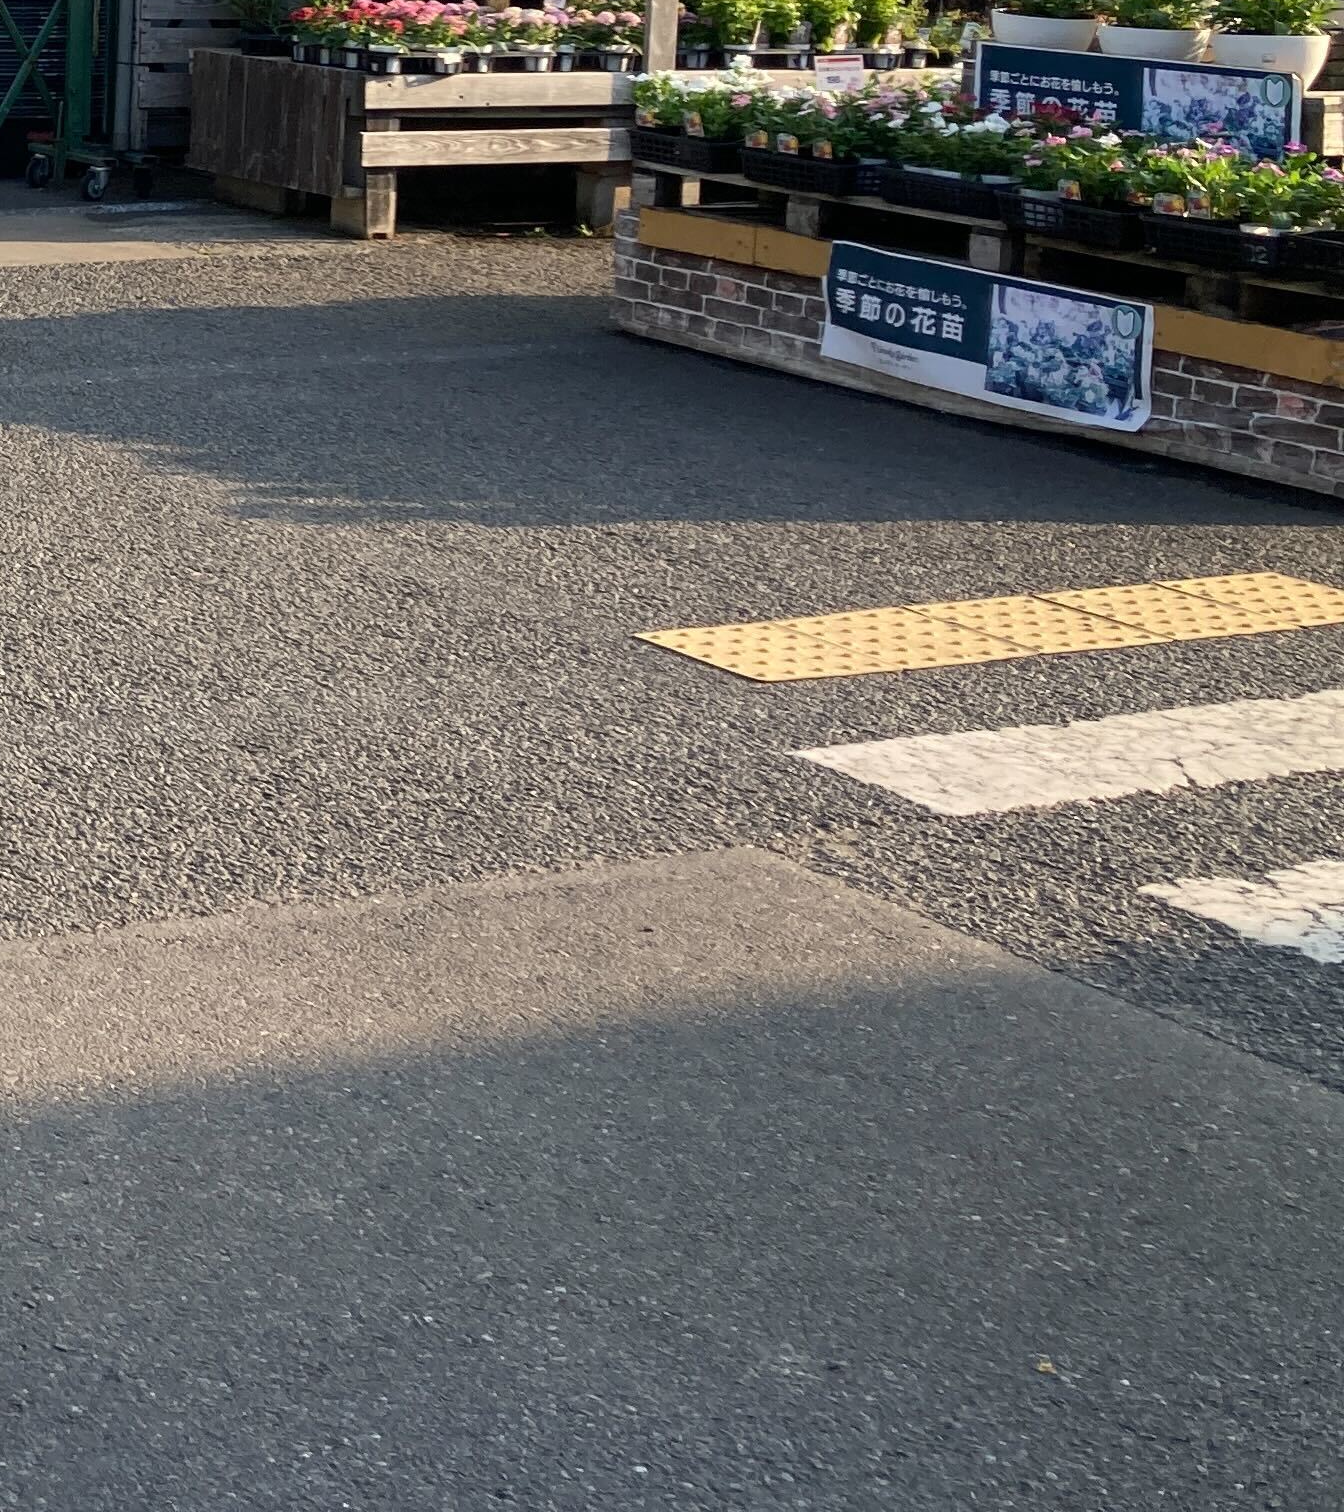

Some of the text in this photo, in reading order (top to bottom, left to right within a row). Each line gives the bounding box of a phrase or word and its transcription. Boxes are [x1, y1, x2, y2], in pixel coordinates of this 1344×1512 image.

[835, 288, 964, 342] 季節の花苗
